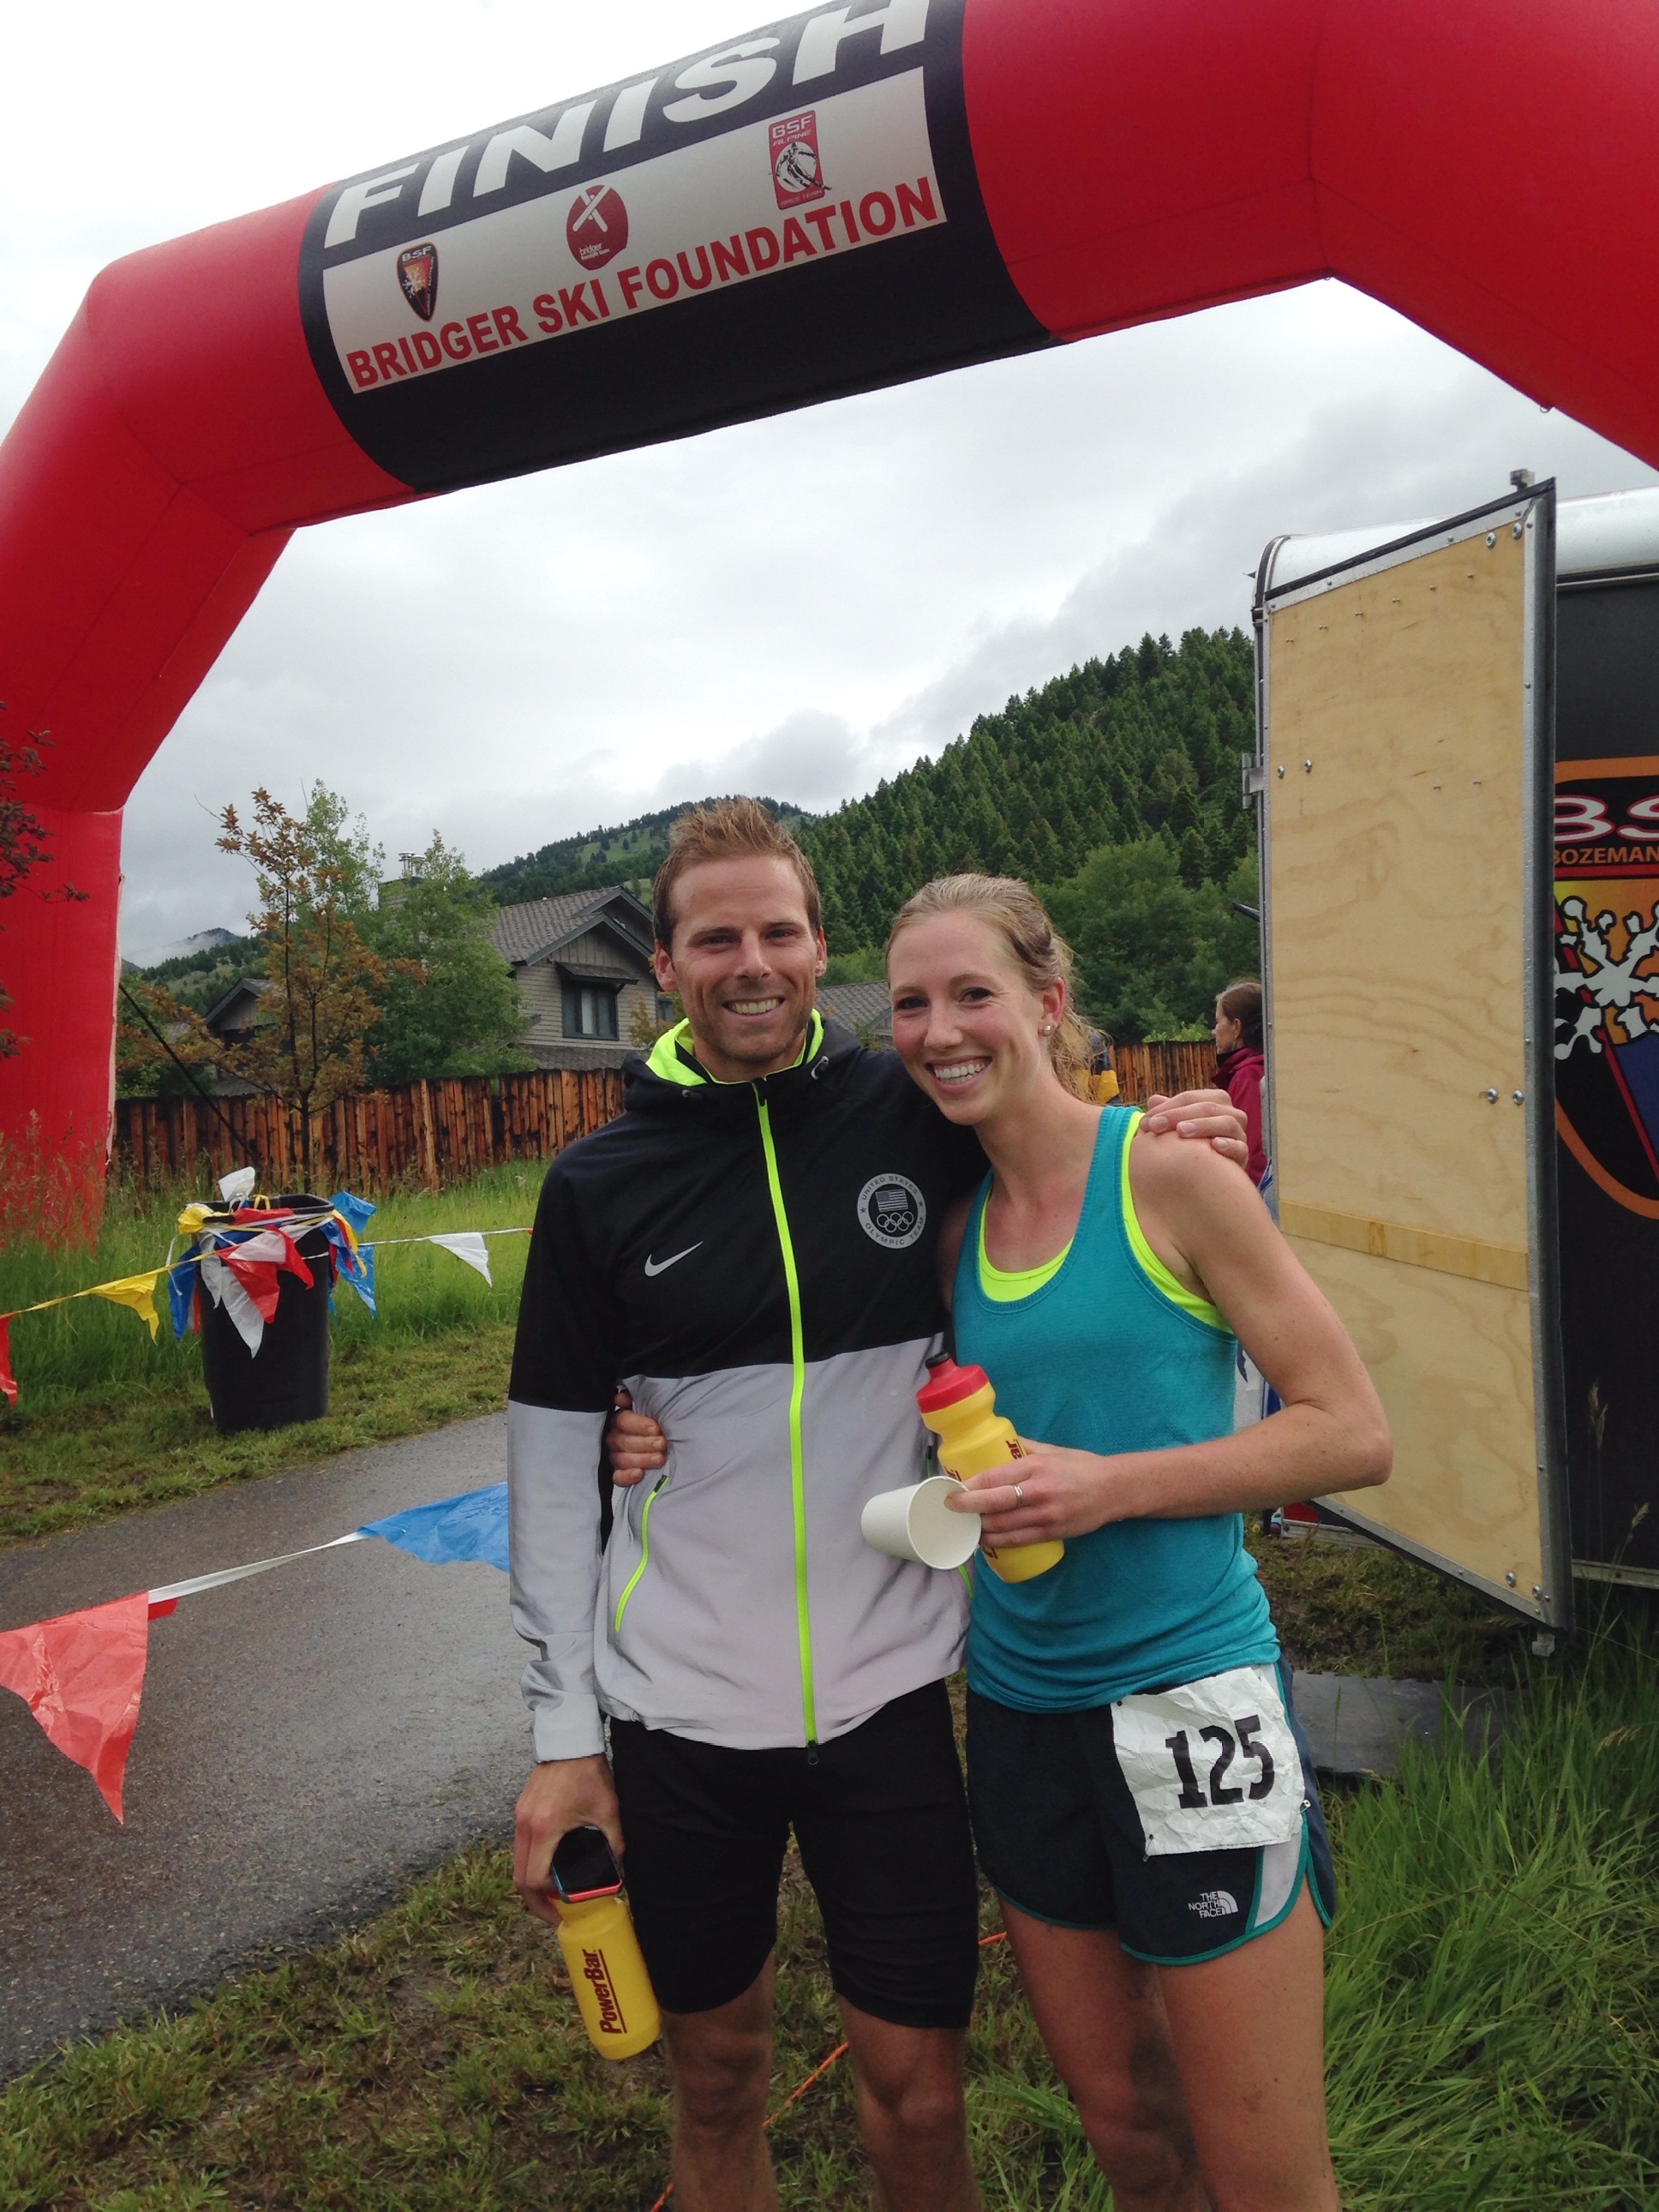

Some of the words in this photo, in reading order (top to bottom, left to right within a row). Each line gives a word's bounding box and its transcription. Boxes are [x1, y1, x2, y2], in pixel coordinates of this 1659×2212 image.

[324, 0, 930, 249] FINISH
[772, 115, 812, 139] BSF
[773, 129, 812, 147] ALPINE
[402, 245, 432, 262] BSF
[579, 243, 602, 256] bridger
[346, 305, 529, 387] BRIDGER
[533, 279, 610, 333] SKI
[617, 177, 937, 310] FOUNDATION
[861, 1177, 885, 1200] UNITED
[889, 1175, 918, 1195] STATES
[865, 1222, 905, 1245] OLYMPIC
[909, 1217, 925, 1239] TEAM
[1165, 1715, 1275, 1809] 125
[1189, 1900, 1220, 1910] NORTH
[1200, 1891, 1218, 1901] THE
[1200, 1908, 1223, 1918] FACE
[582, 1948, 622, 2034] PowerBar
